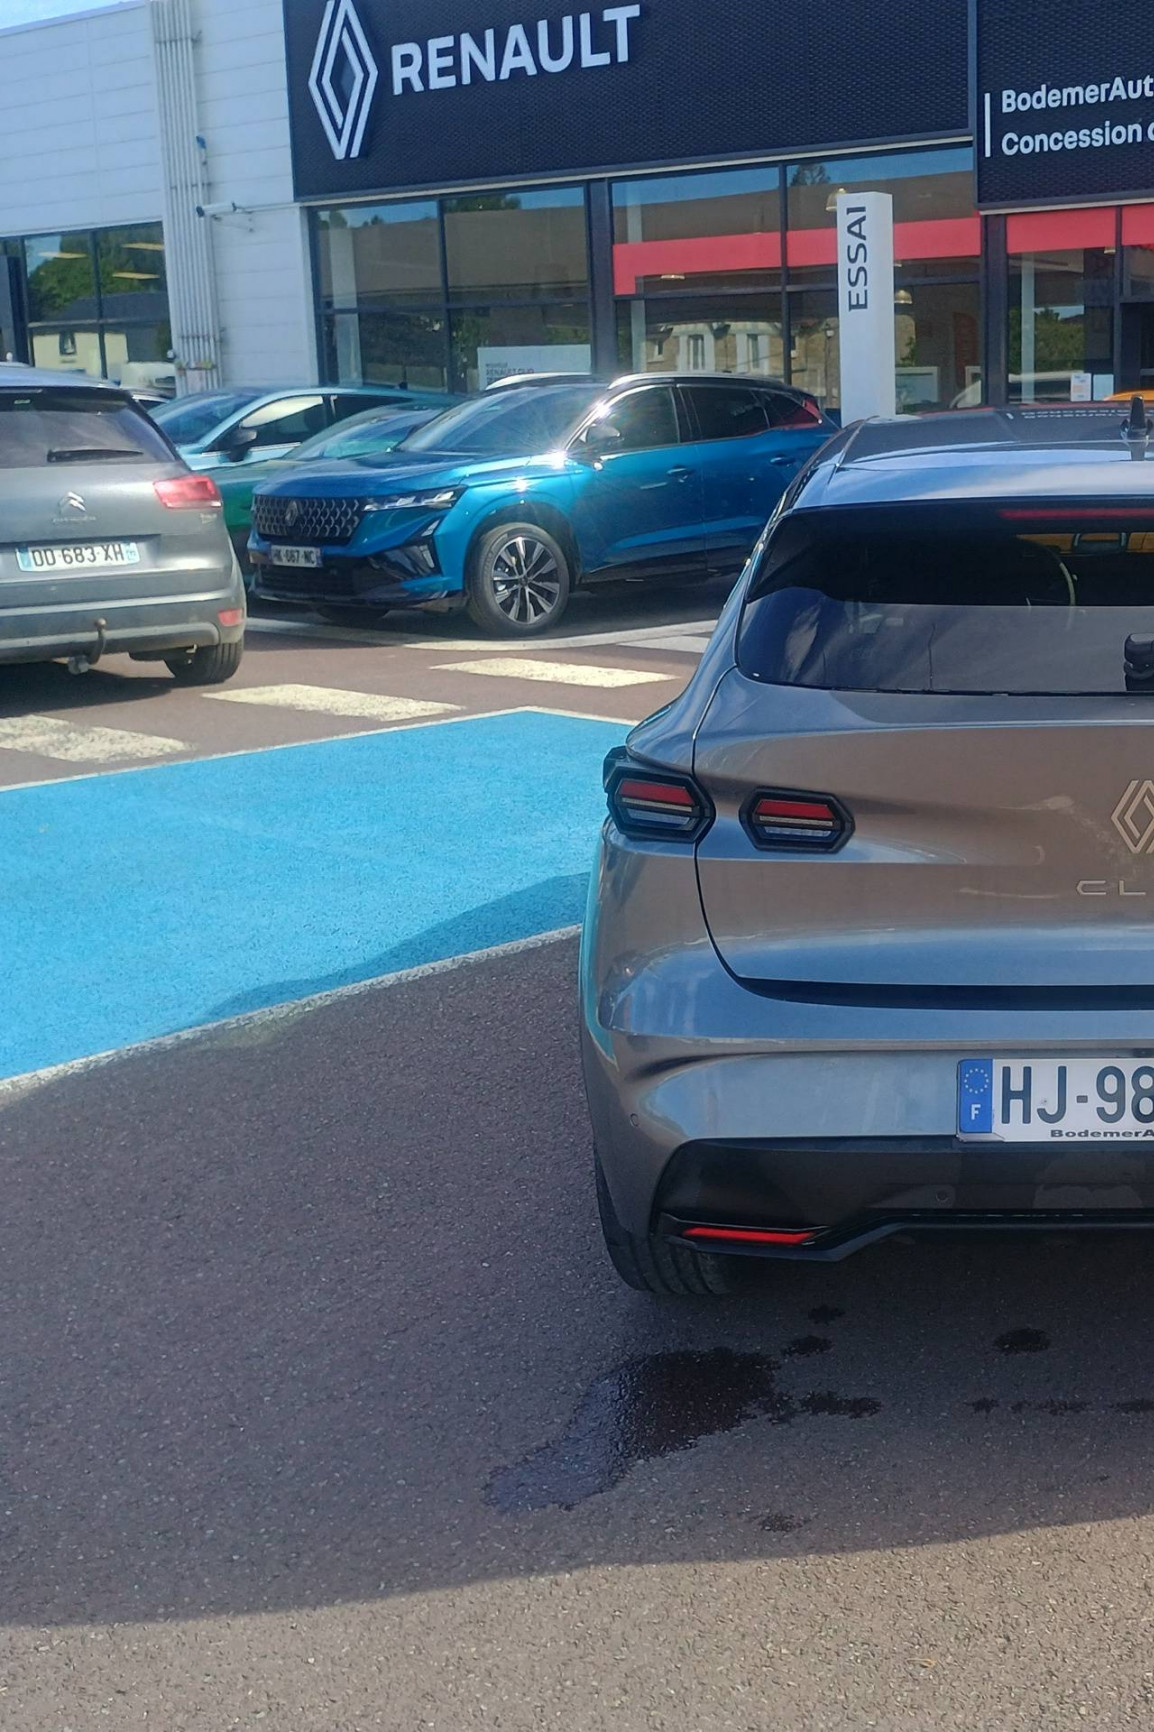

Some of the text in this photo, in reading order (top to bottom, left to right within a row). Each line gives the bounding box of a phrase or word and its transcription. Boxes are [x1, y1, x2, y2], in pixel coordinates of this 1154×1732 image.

[391, 4, 641, 95] RENAULT
[1001, 121, 1142, 156] Concession
[846, 206, 868, 312] ESSAI
[970, 1104, 981, 1121] F
